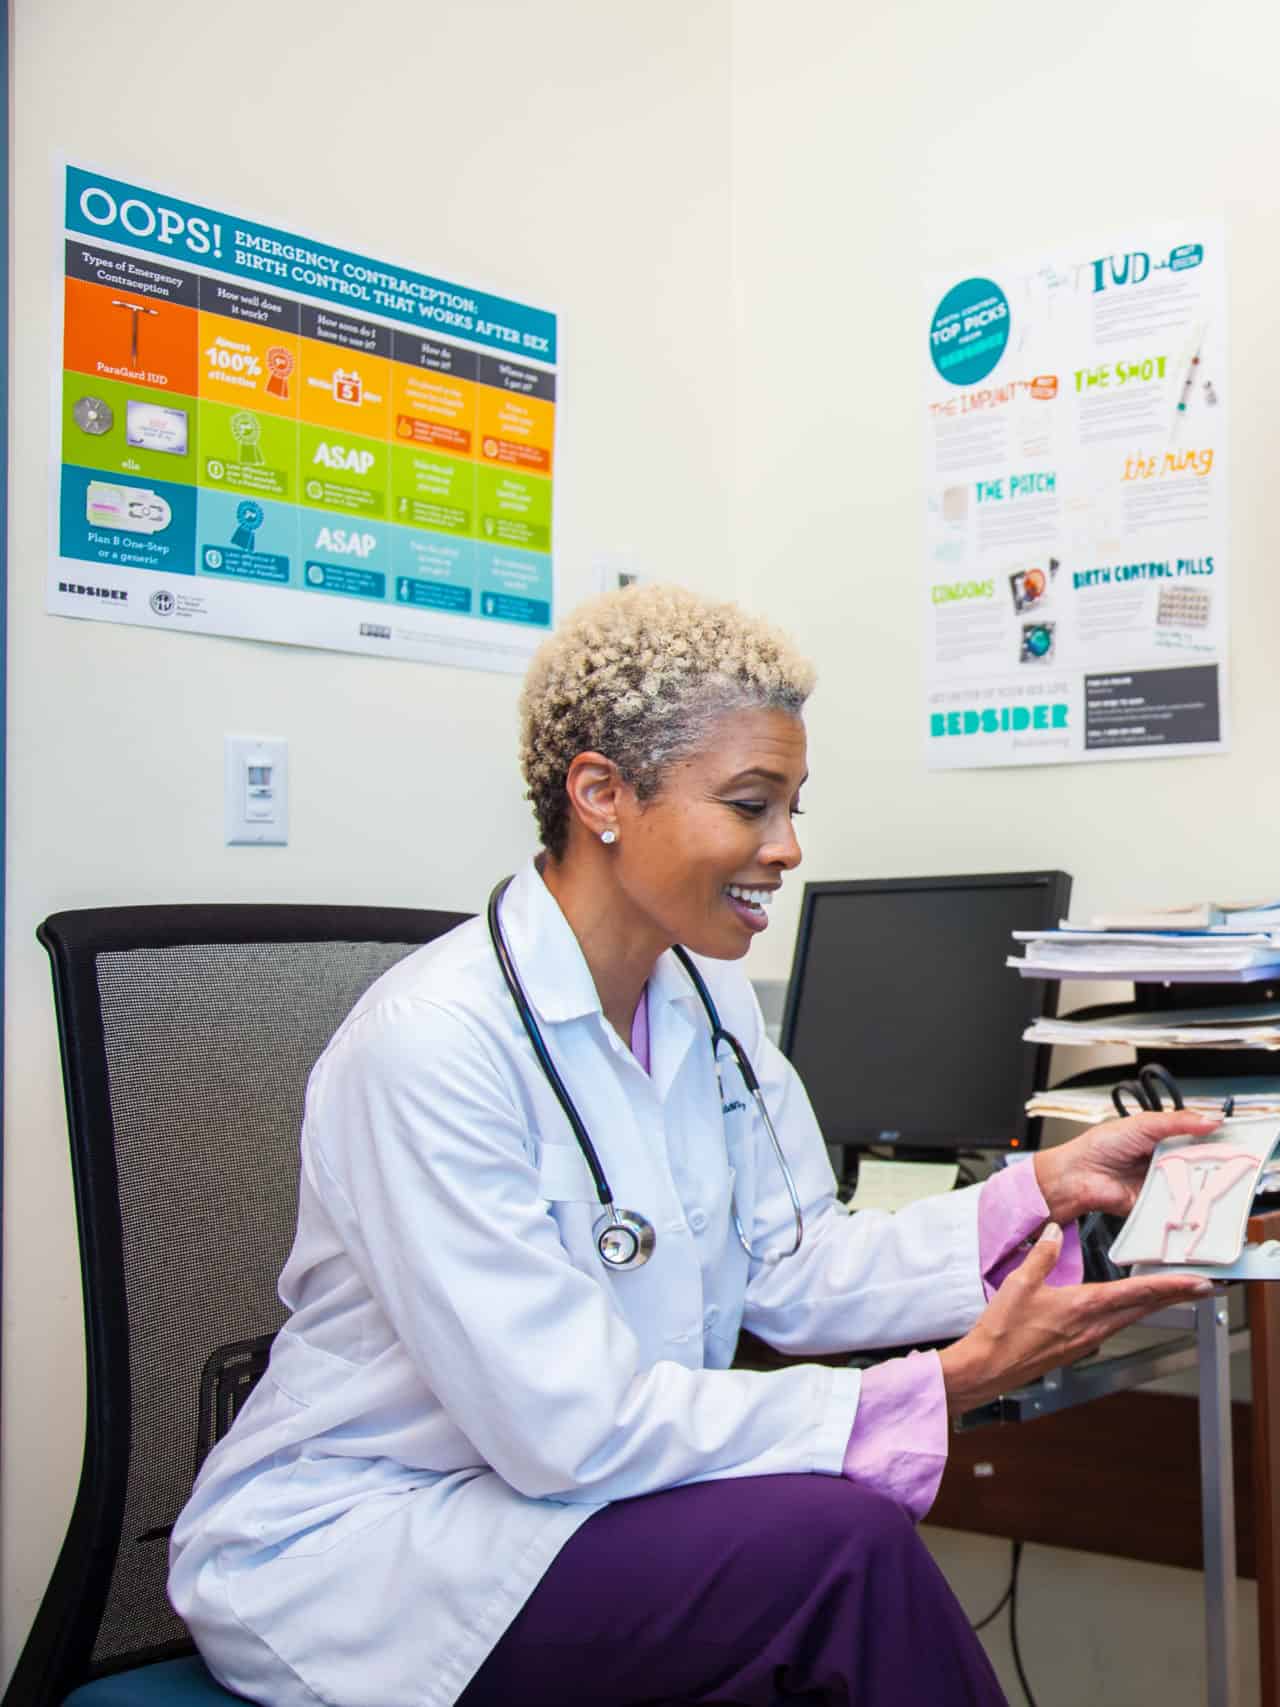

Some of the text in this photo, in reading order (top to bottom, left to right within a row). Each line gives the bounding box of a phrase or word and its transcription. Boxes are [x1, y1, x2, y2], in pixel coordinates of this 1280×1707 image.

[80, 187, 222, 258] OOPS!
[81, 251, 184, 288] Types of Emergency
[97, 270, 169, 296] Contraception
[234, 230, 479, 314] EMERGENCY CONTRACEPTION:
[1090, 251, 1150, 294] IUD
[217, 287, 239, 301] How
[234, 250, 549, 352] BIRTH CONTROL THAT WORKS AFTER SEX
[932, 322, 961, 345] TOP
[963, 301, 1007, 332] PICKS
[205, 346, 263, 376] 100%
[1074, 364, 1110, 393] THE
[1115, 355, 1168, 385] SHOT
[147, 372, 169, 385] IUD
[312, 442, 375, 474] ASAP
[976, 478, 1004, 503] THE
[88, 532, 111, 546] Plan
[122, 537, 170, 555] One-Step
[314, 527, 377, 558] ASAP
[1073, 556, 1215, 590] BIRTH CONTROL PILLS
[58, 581, 128, 601] BEDSIDER
[930, 703, 1069, 738] BEDSIDER
